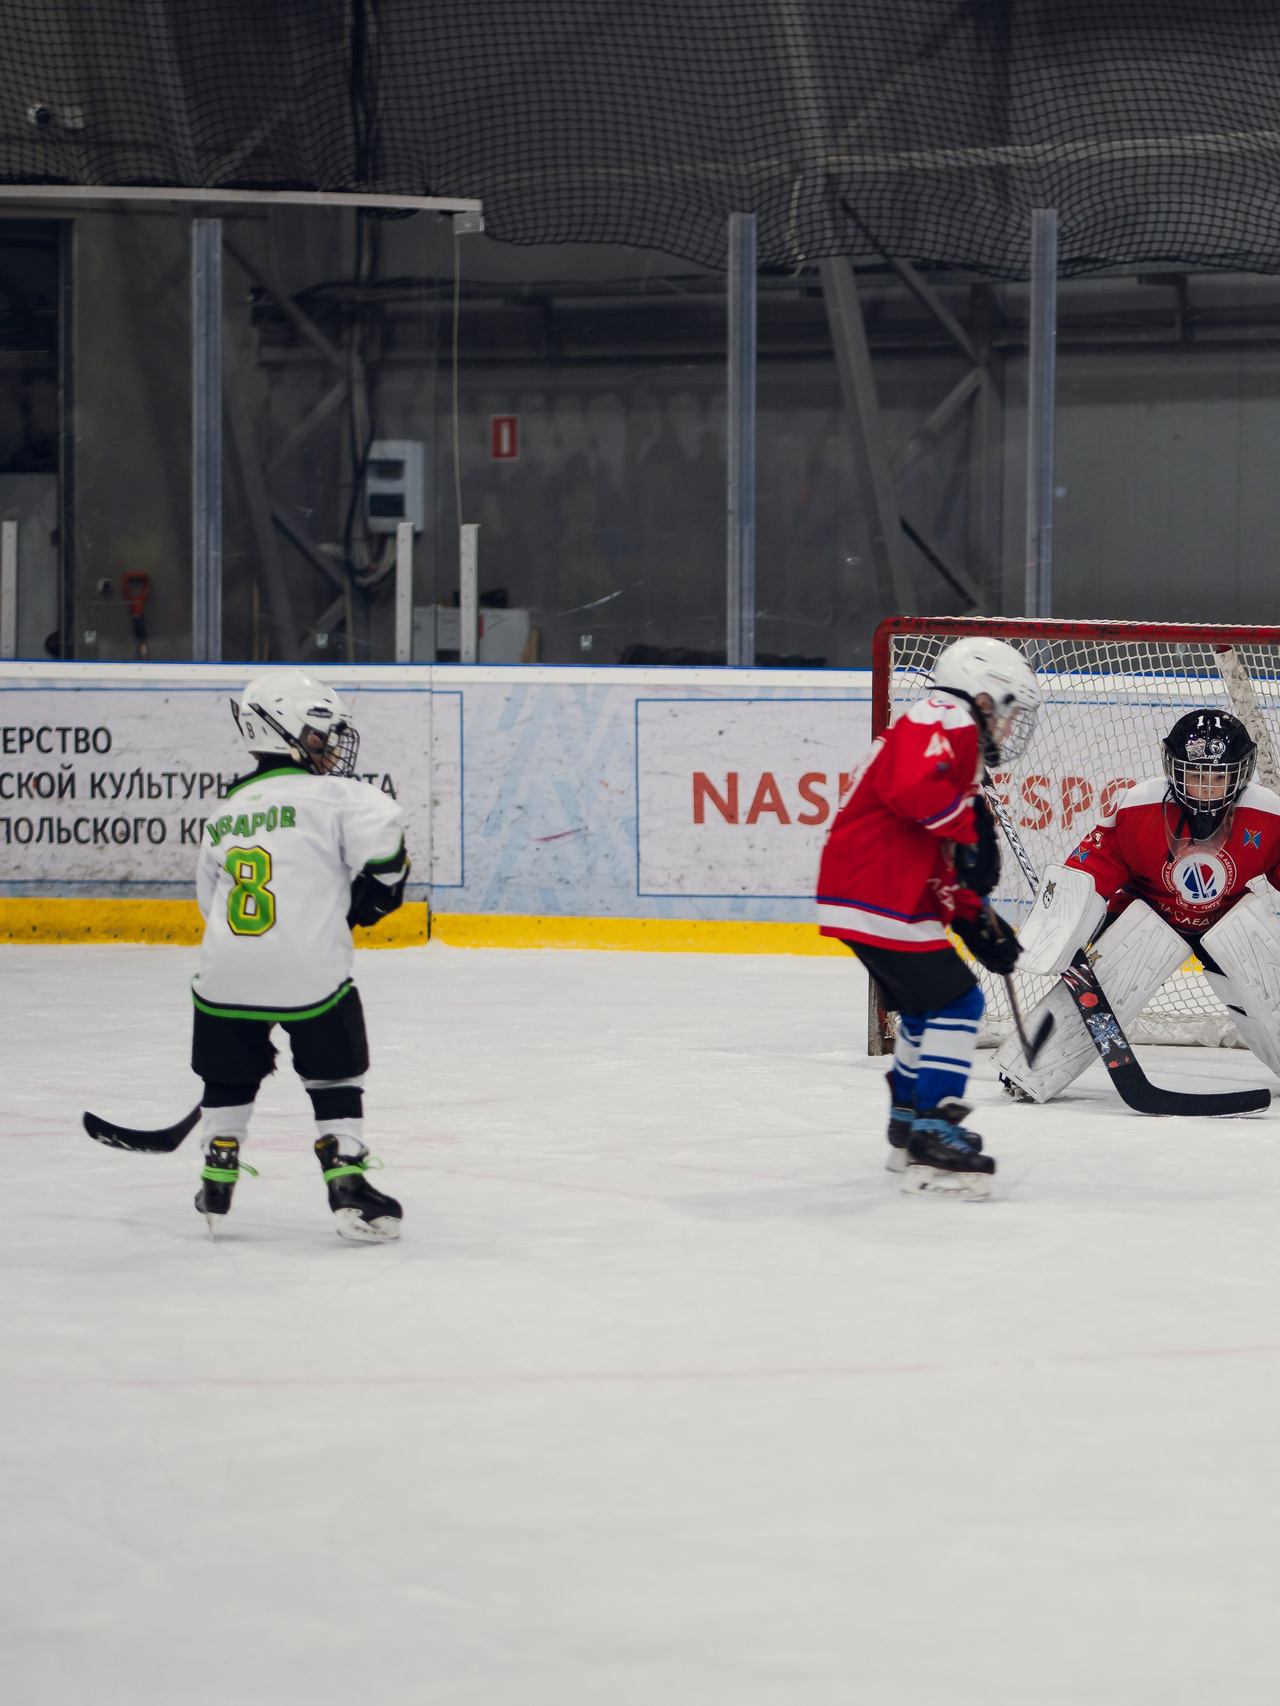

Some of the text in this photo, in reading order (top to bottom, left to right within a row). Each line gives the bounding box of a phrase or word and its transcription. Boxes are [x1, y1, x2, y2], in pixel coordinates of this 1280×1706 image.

[0, 726, 112, 754] ЕРСТВО
[245, 721, 255, 740] 8
[90, 767, 239, 800] КУЛЬТУРЫ
[206, 805, 297, 848] УВАРОВ
[225, 845, 276, 936] 8
